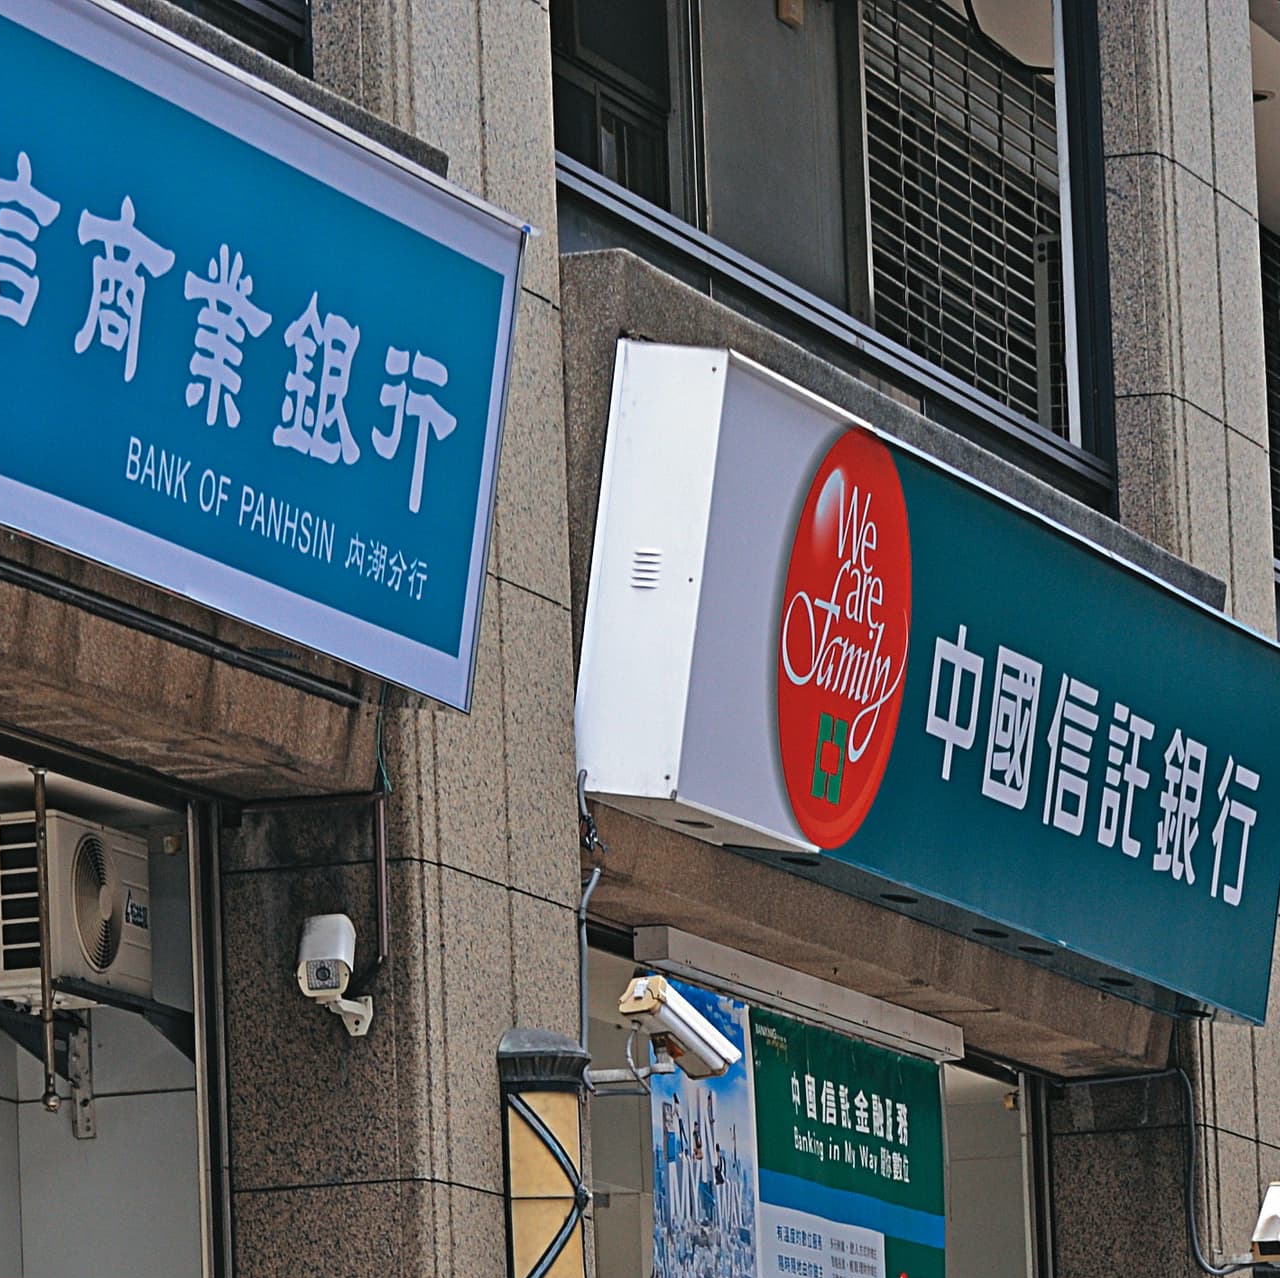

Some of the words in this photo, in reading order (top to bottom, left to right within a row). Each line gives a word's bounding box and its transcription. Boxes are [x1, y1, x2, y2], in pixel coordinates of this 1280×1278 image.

[125, 436, 192, 503] BANK
[199, 468, 232, 516] OF
[238, 485, 335, 563] PANHSIN
[344, 532, 428, 601] 內湖分行
[814, 467, 878, 573] We
[782, 559, 910, 762] Family
[845, 567, 883, 629] are
[924, 624, 1261, 907] 中國信託銀行
[793, 1125, 824, 1161] Banking
[828, 1136, 840, 1161] in
[844, 1140, 856, 1168] My
[859, 1143, 878, 1175] Way
